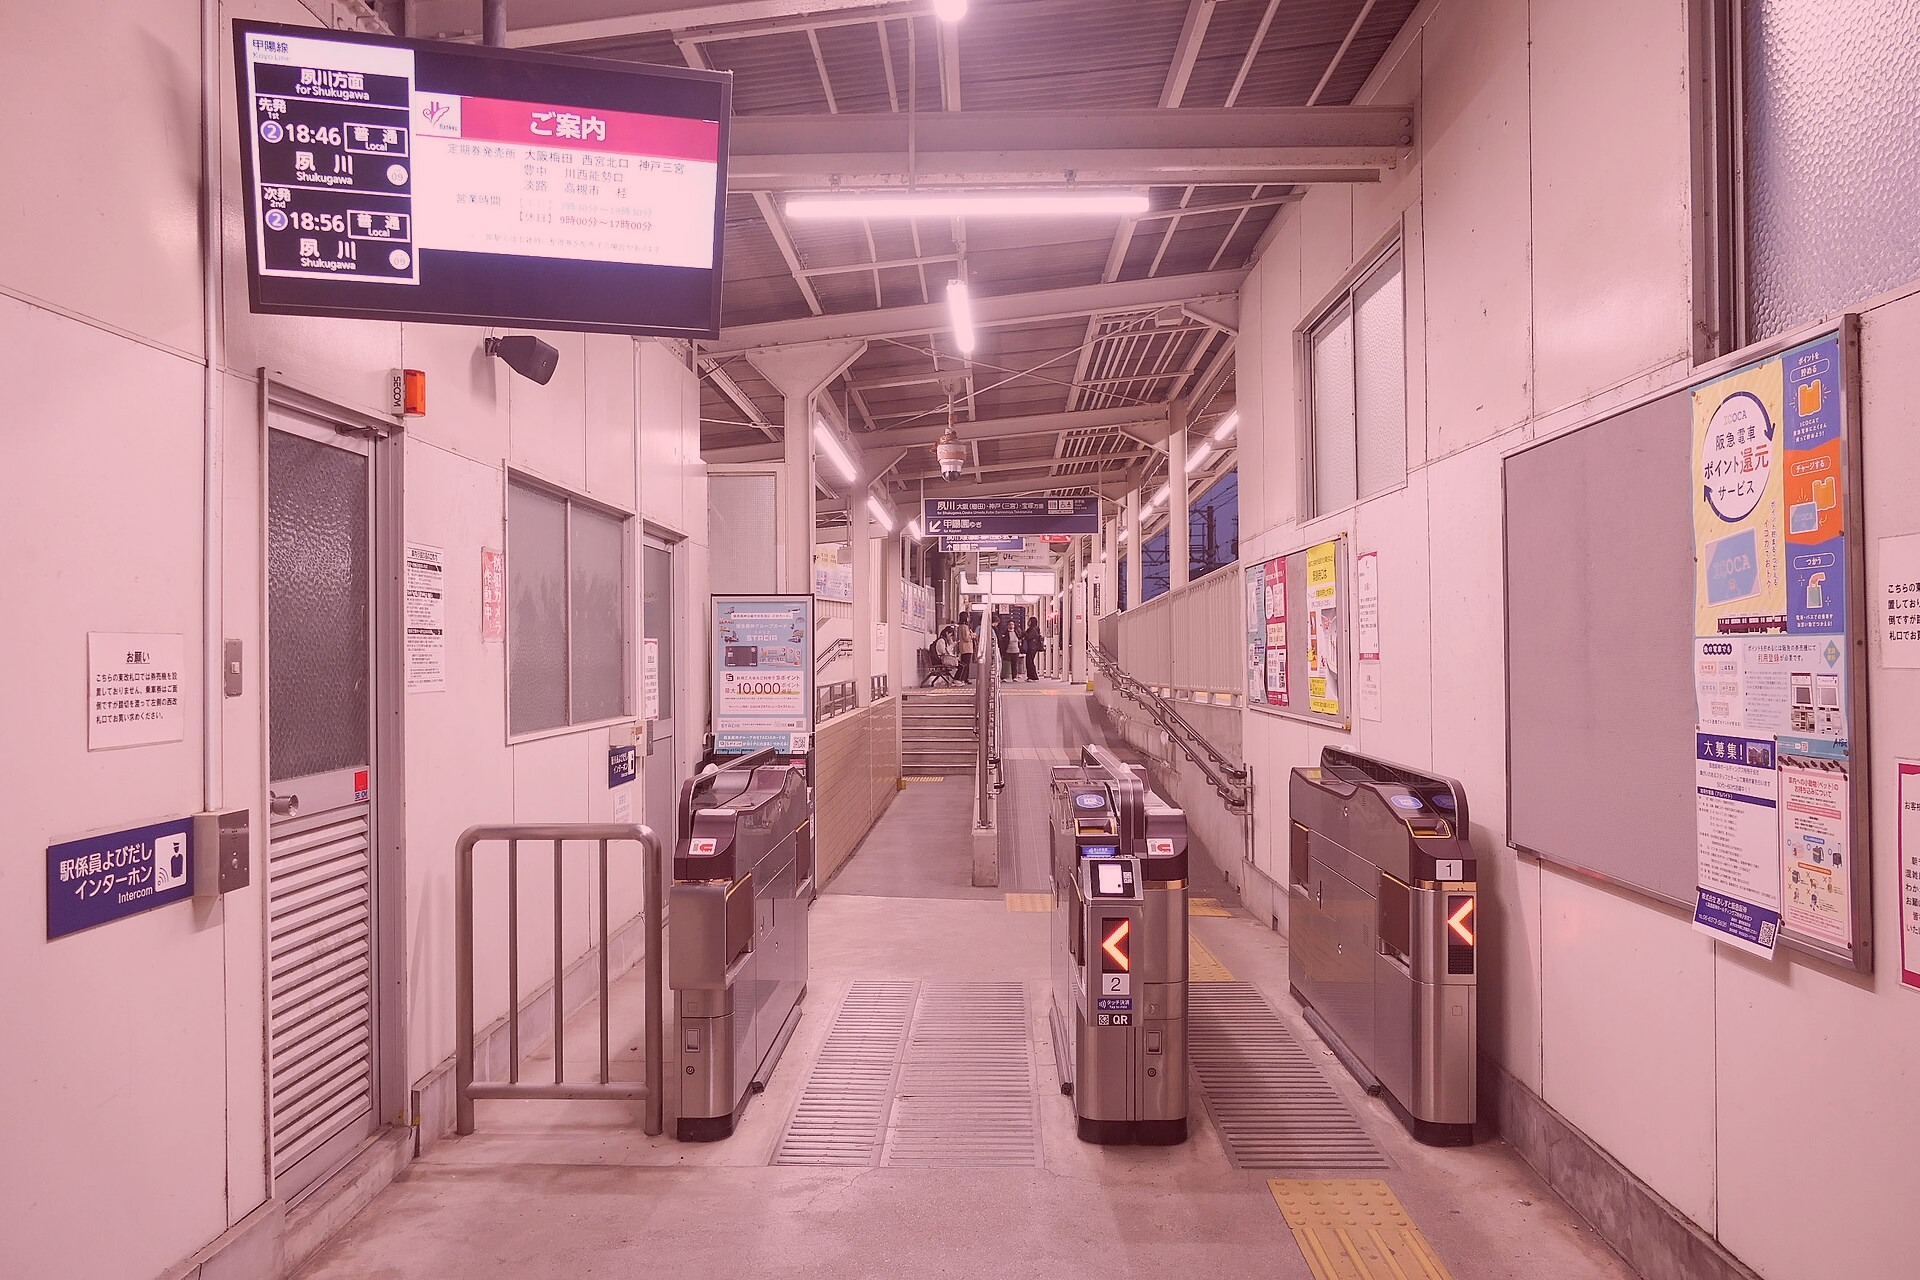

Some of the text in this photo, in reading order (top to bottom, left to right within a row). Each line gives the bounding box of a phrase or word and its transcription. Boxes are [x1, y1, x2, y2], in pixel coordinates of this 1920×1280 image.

[252, 39, 289, 54] 甲陽線
[300, 68, 365, 91] 夙川方面
[295, 84, 370, 101] for Shukugawa
[258, 97, 287, 113] 先発
[285, 123, 342, 146] 18:46
[529, 111, 607, 142] ご案内
[365, 142, 388, 152] Local
[447, 142, 686, 175] 定期券発売所 大阪梅田 西宮北口 神戸三宮
[296, 171, 354, 186] Shukugawa
[523, 164, 624, 184] 豊中 川西能勢口
[263, 187, 291, 202] 次発
[563, 182, 600, 197] 高槻市
[289, 211, 345, 233] 18:56
[368, 228, 391, 238] Local
[300, 259, 357, 271] Shukugawa
[1800, 364, 1818, 378] 貯める
[393, 376, 402, 407] SECOM
[1715, 425, 1756, 452] 阪急電車
[1704, 444, 1770, 480] ポイント還元
[1795, 460, 1826, 474] チャージする
[1718, 480, 1755, 501] サービス
[937, 500, 956, 511] 夙川
[1712, 554, 1751, 580] ICOCA
[1805, 557, 1822, 566] つかう
[746, 634, 778, 642] STACIA
[126, 651, 151, 663] お願い
[736, 682, 781, 695] 10,000
[1703, 740, 1743, 761] 大募集!
[59, 842, 153, 882] 駅係員よびだし
[1445, 863, 1453, 878] 1
[75, 866, 153, 901] インターホン
[118, 887, 154, 904] Intercom
[1110, 976, 1121, 992] 2
[1112, 1014, 1129, 1025] QR
